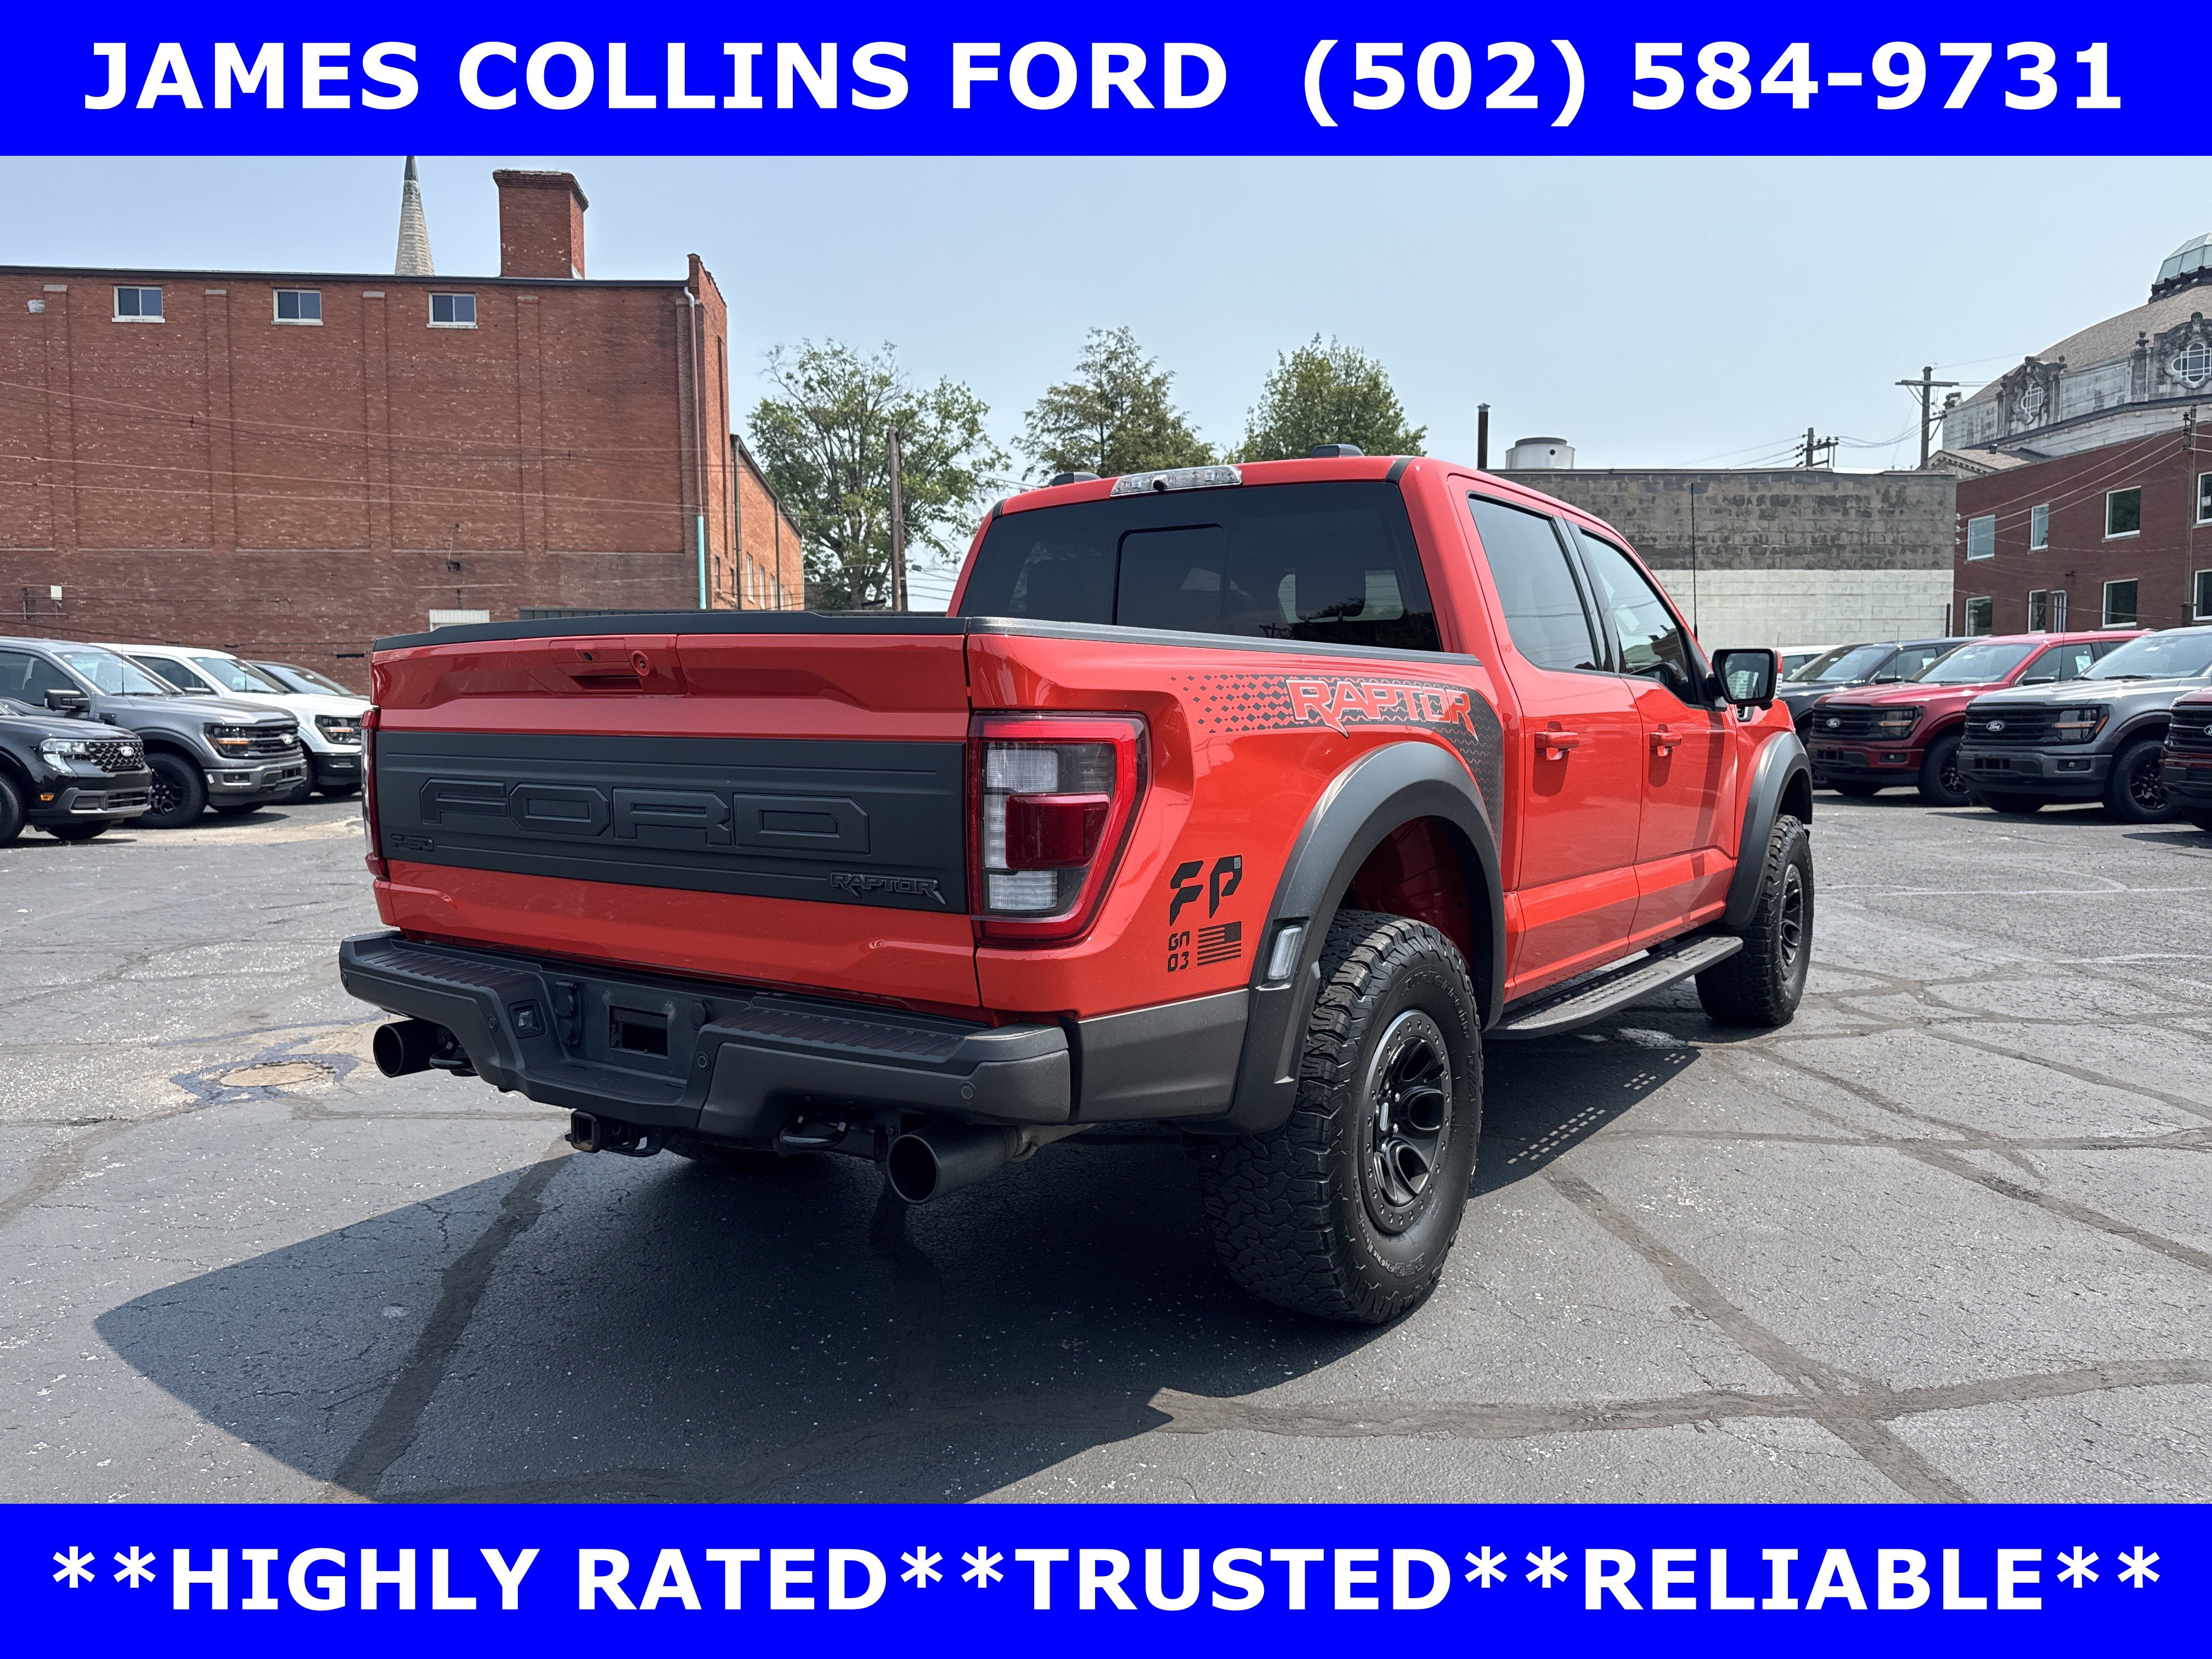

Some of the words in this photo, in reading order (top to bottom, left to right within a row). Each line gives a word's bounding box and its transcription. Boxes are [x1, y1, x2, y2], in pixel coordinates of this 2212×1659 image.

[1286, 679, 1479, 742] RAPTOR
[420, 778, 870, 855] FORD
[830, 870, 947, 906] RAPTOR
